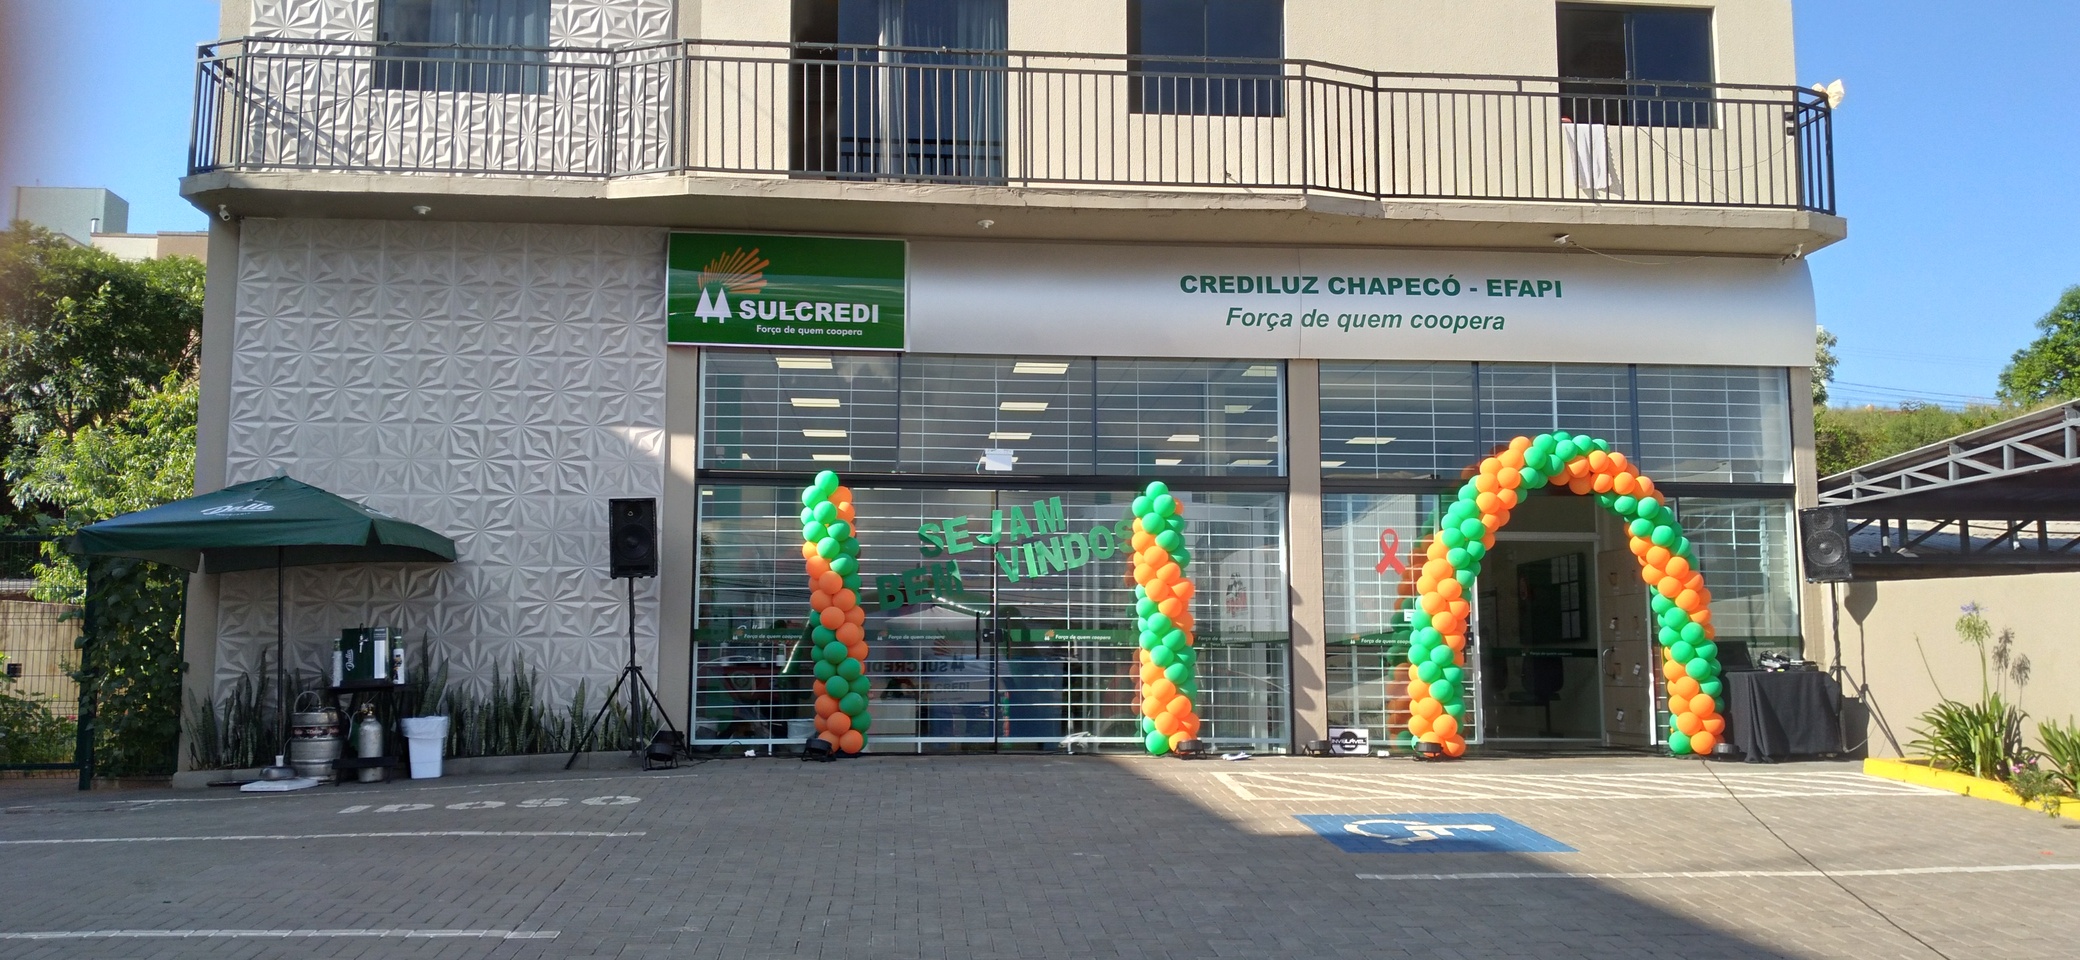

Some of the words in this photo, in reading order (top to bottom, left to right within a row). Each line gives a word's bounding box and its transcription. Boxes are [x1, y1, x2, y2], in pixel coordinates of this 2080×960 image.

[1180, 274, 1319, 294] CREDILUZ
[1328, 274, 1461, 296] CHAPECÓ
[1487, 279, 1562, 298] EFAPI
[739, 300, 879, 323] SULCREDI
[1226, 307, 1292, 331] Força
[1301, 309, 1329, 328] de
[1338, 313, 1402, 332] quem
[1410, 313, 1505, 333] coopera
[756, 325, 781, 335] Força
[784, 326, 795, 334] de
[798, 327, 824, 335] quem
[826, 328, 863, 336] coopera
[876, 559, 964, 611] BEM
[994, 519, 1135, 583] VINDOS
[337, 796, 641, 814] IDOSO
